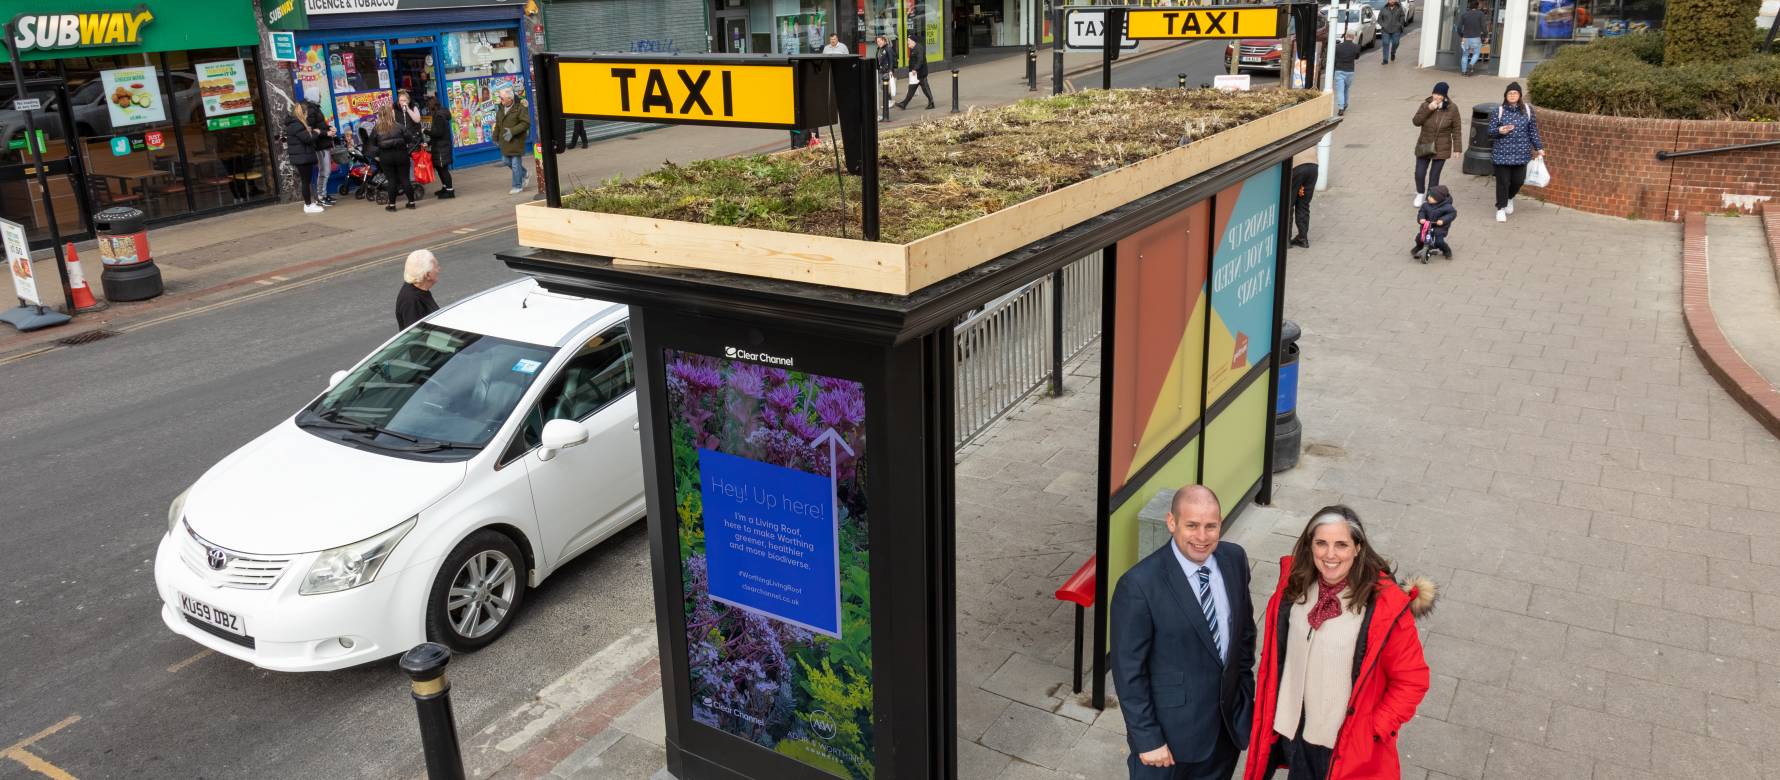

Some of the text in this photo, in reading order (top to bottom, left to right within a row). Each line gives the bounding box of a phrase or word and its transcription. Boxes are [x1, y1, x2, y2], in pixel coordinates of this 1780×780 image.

[269, 0, 295, 25] SUBWAY
[308, 0, 345, 10] LICENCE
[354, 0, 395, 8] TOBACCO
[15, 10, 154, 49] SUBWAY
[1163, 12, 1239, 35] TAXI
[611, 68, 733, 117] TAXI
[737, 349, 793, 366] Clear Channel
[711, 477, 824, 520] Hey! Up here!
[724, 519, 815, 552] here to make Worthing
[734, 512, 747, 523] I'm
[755, 518, 779, 532] Living
[781, 524, 802, 537] Roof,
[729, 541, 811, 570] and more biodiverse.
[735, 533, 804, 558] greener, healthier
[181, 594, 239, 631] KU59 DBZ
[714, 701, 765, 726] Clear Channel
[818, 743, 864, 766] WORTHING
